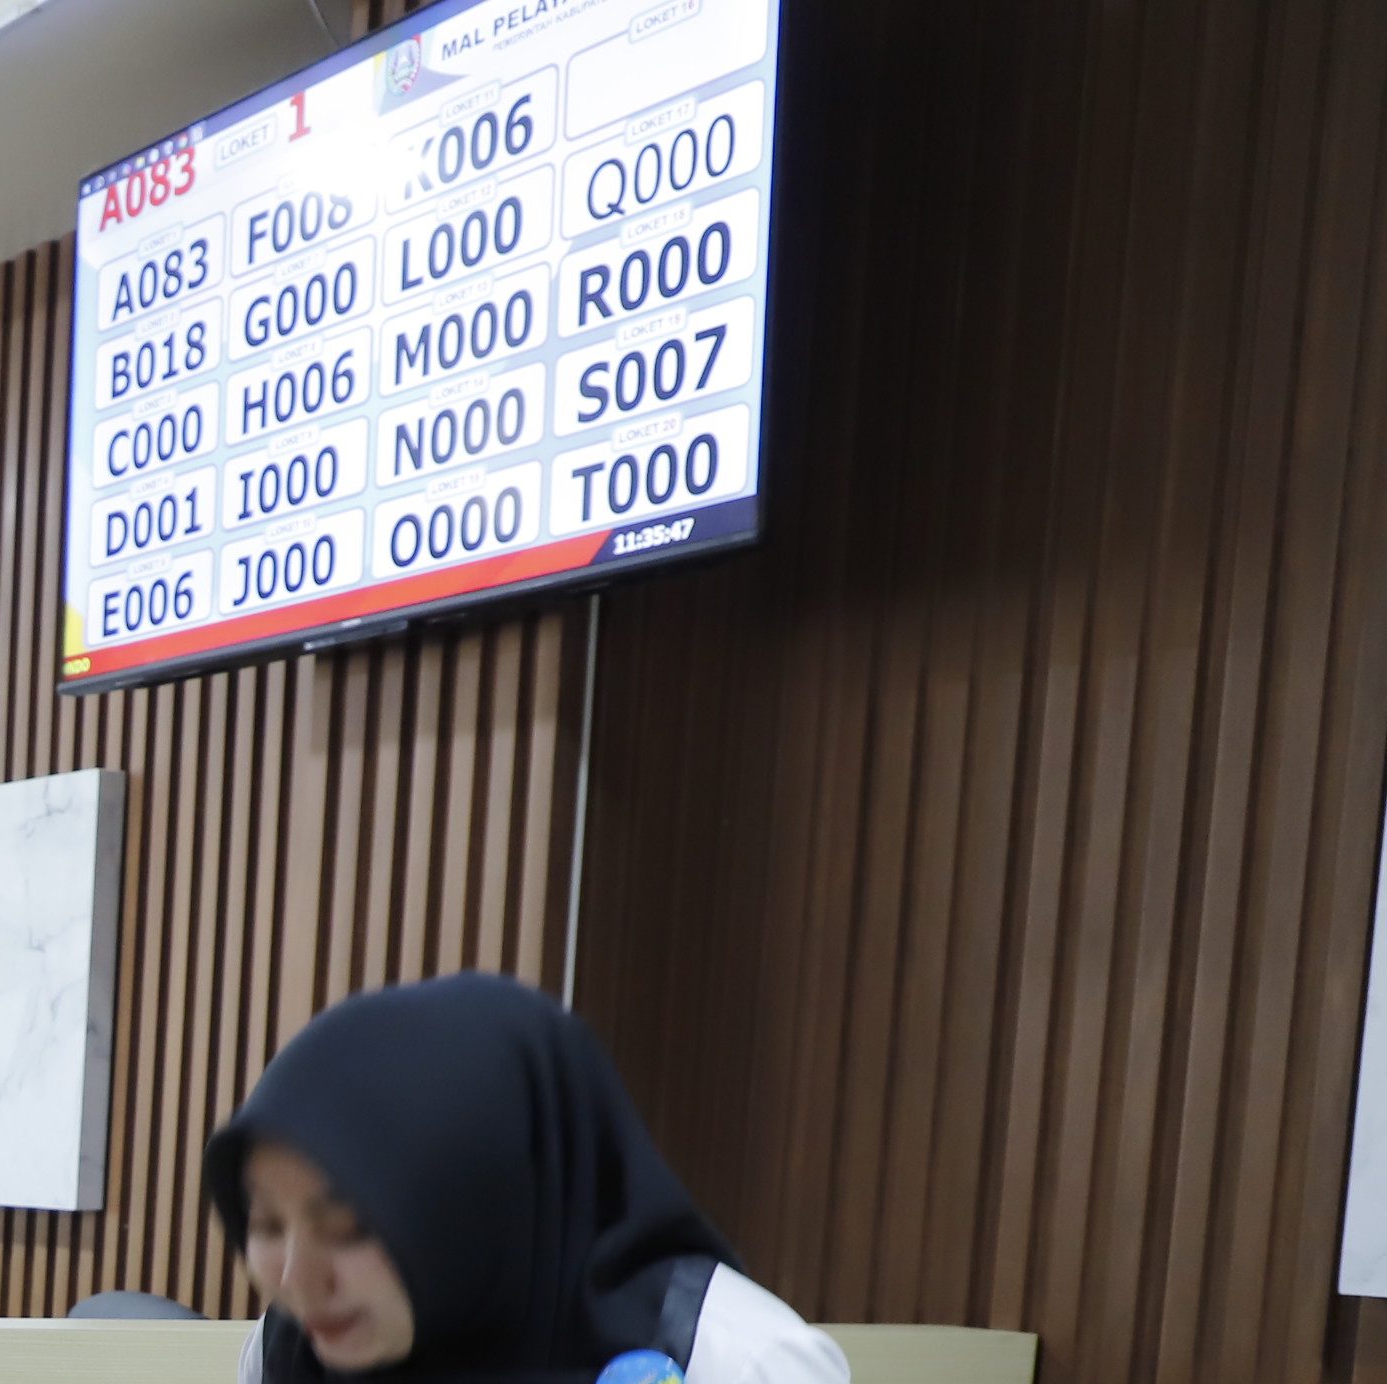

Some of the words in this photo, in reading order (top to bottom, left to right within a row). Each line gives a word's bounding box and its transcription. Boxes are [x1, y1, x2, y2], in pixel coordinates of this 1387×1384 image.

[441, 28, 484, 61] MAL
[636, 6, 677, 33] LOKET
[99, 147, 195, 232] A083
[220, 124, 269, 161] LOKET
[288, 91, 311, 143] 1
[632, 111, 673, 136] LOKET
[587, 113, 737, 220] Q000
[401, 196, 523, 292] L000
[627, 217, 668, 239] LOKET
[111, 238, 209, 322] A083
[244, 261, 358, 347] G000
[578, 220, 732, 327] R000
[111, 320, 206, 399] B018
[395, 289, 534, 386] M000
[624, 320, 664, 340] LOKET
[242, 349, 355, 435] H006
[577, 323, 728, 424] S007
[108, 404, 203, 477] C000
[394, 387, 526, 477] N000
[619, 425, 660, 443] LOKET
[238, 445, 339, 521] I000
[571, 432, 719, 523] T000
[106, 486, 202, 557] D001
[390, 486, 523, 568] O000
[613, 517, 696, 555] 11:35:47
[102, 570, 194, 638] E006
[233, 534, 336, 608] J000
